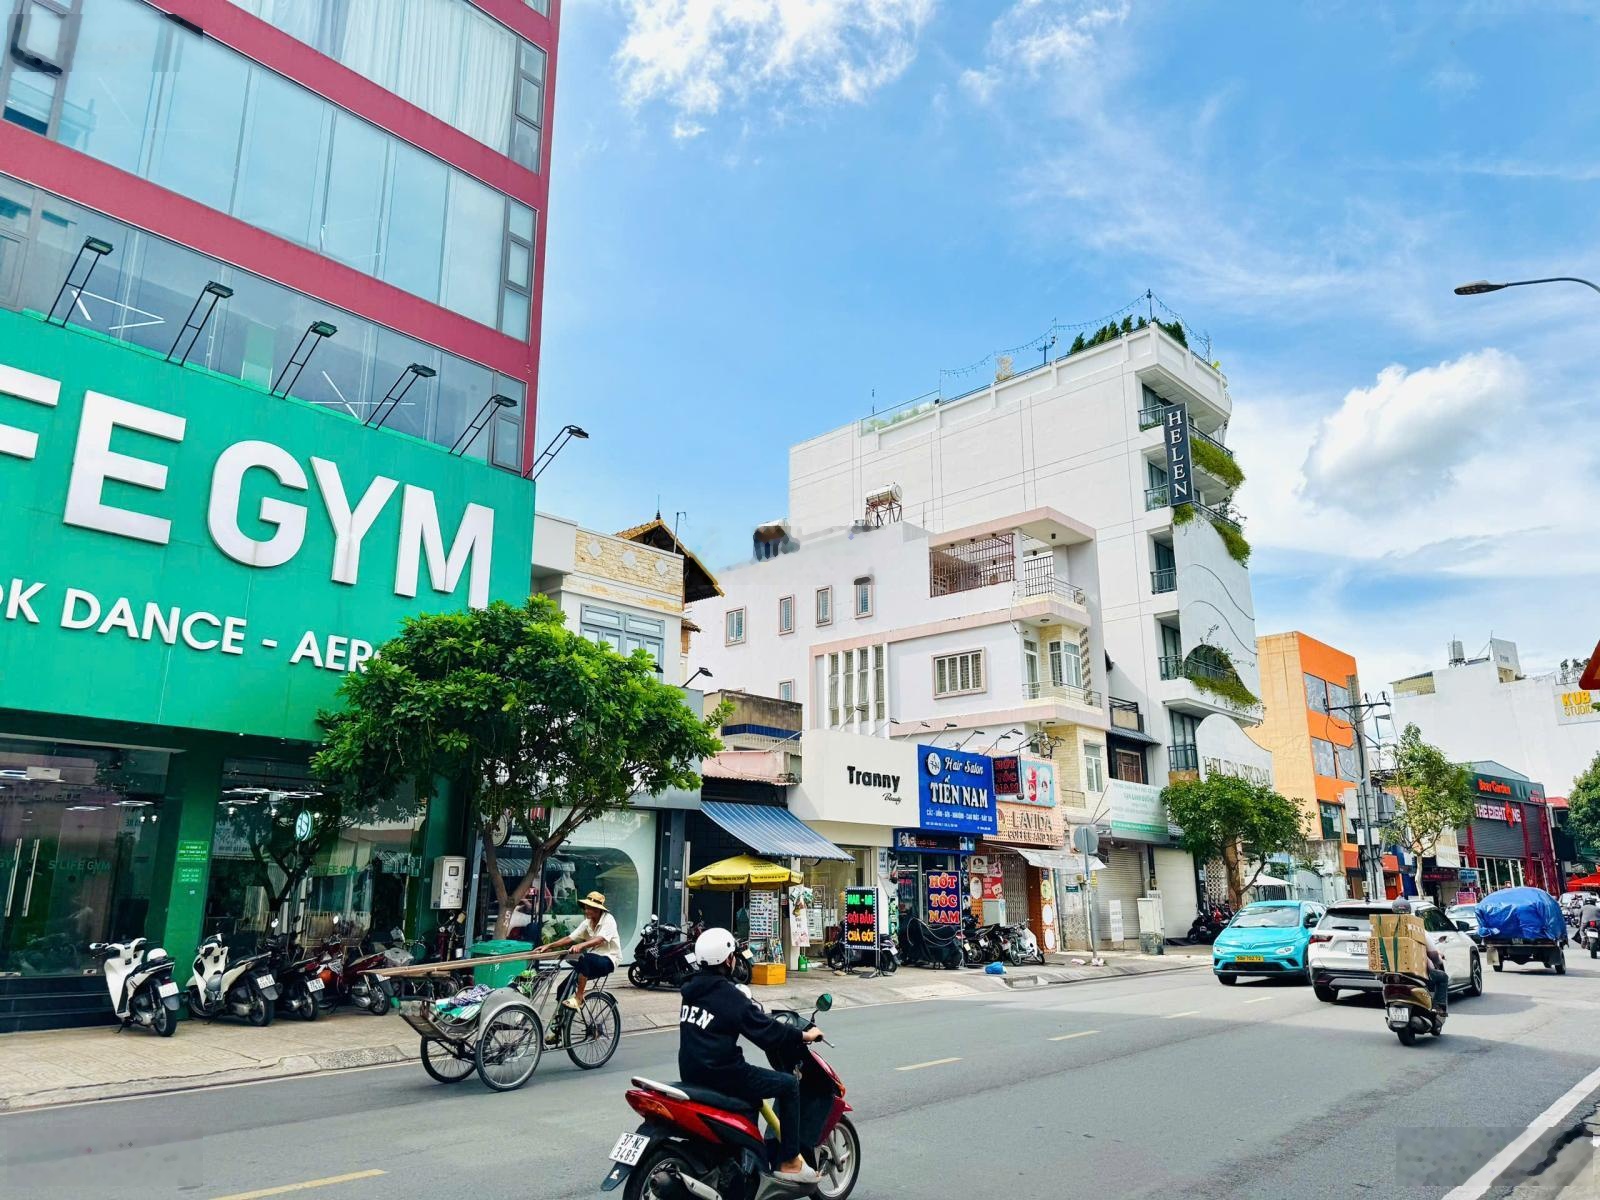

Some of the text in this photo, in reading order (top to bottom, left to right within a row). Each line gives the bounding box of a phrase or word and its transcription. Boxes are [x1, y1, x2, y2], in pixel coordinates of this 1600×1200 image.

[1168, 410, 1188, 497] HELEN
[208, 440, 495, 610] GYM
[61, 588, 247, 655] DANCE
[290, 630, 382, 674] AER
[846, 765, 901, 793] Tranny
[944, 757, 984, 775] Hair Salon
[930, 775, 988, 809] TIẾN NAM
[929, 872, 957, 889] HỚT
[930, 891, 957, 907] TÓC
[929, 910, 960, 924] NAM
[681, 1005, 714, 1029] DEN
